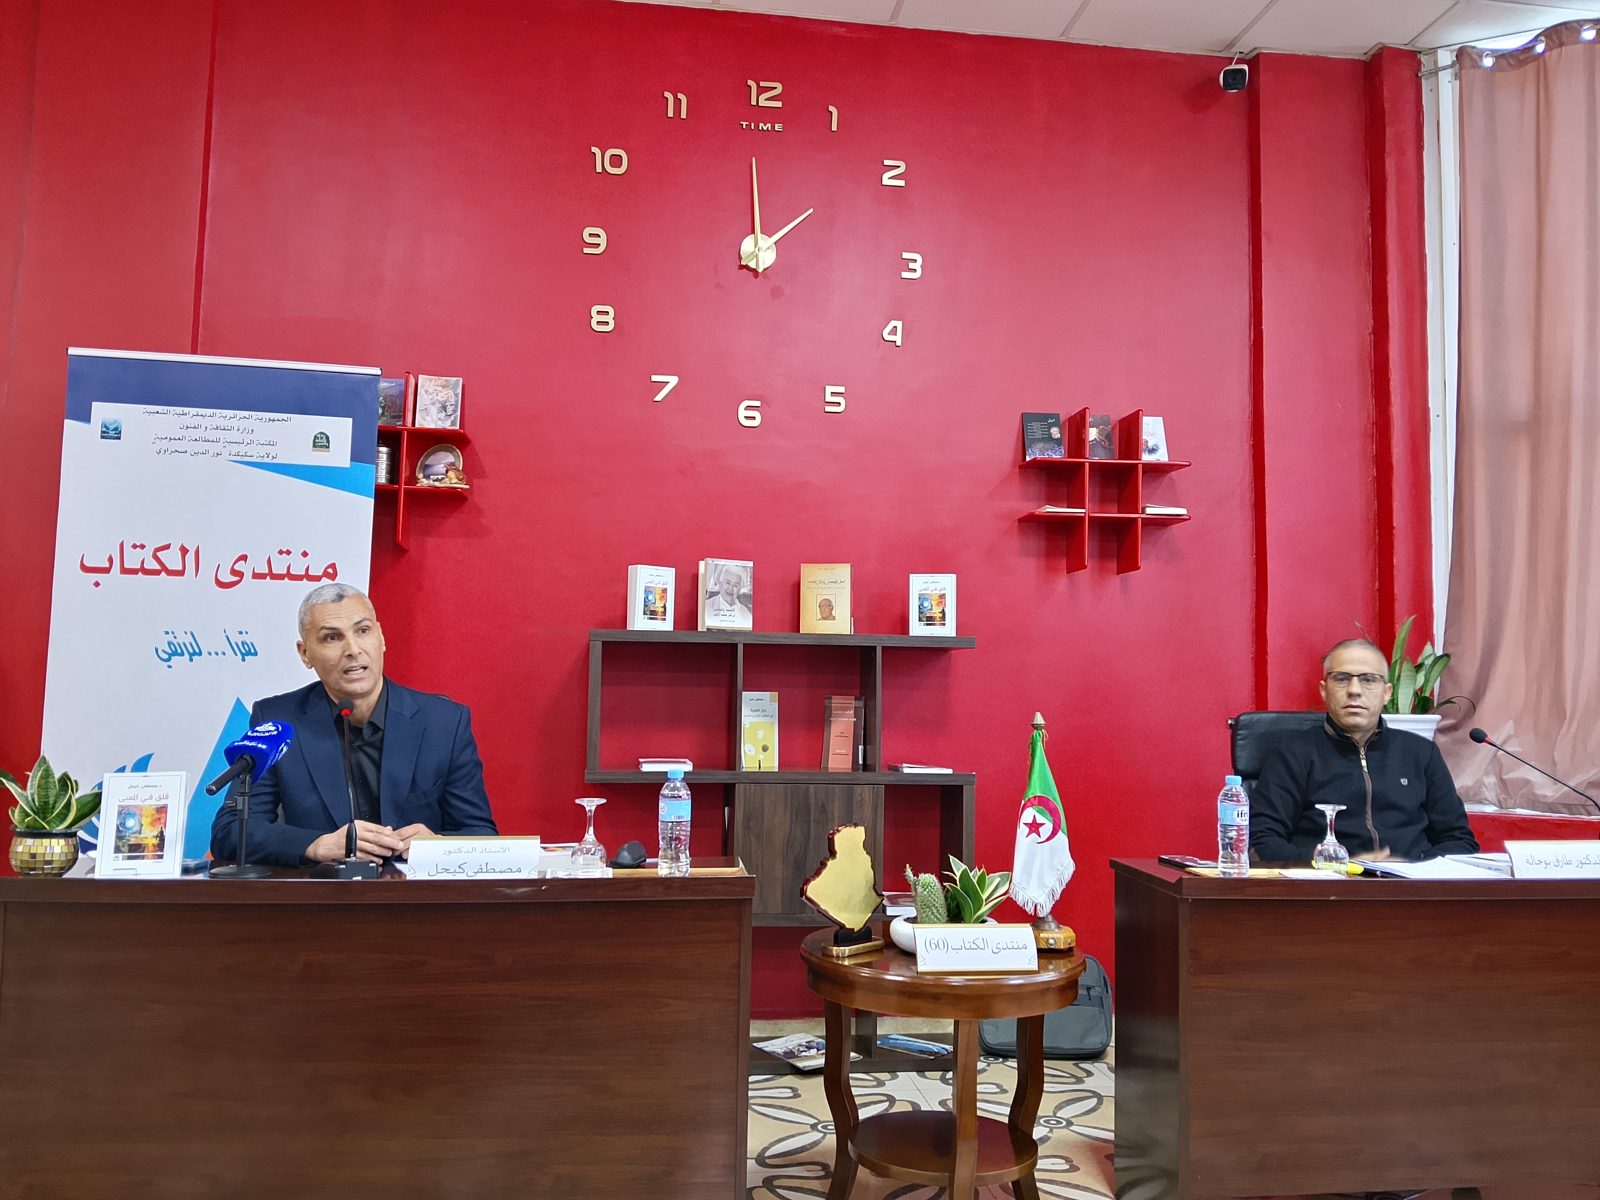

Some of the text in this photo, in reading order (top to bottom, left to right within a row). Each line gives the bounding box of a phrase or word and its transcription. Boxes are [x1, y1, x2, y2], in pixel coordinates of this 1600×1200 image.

[747, 79, 783, 108] 12
[663, 91, 688, 119] 11
[740, 121, 784, 132] TIME
[828, 105, 838, 132] 1
[590, 146, 628, 175] 10
[881, 159, 906, 187] 2
[582, 226, 607, 255] 9
[901, 252, 923, 280] 3
[590, 305, 615, 332] 8
[882, 320, 903, 346] 4
[650, 374, 679, 402] 7
[824, 385, 846, 413] 5
[142, 407, 292, 423] الجمهورية الجزائرية الديمقراطية الشعبية
[737, 399, 762, 428] 6
[179, 422, 202, 431] الفنون
[209, 423, 235, 431] الثقافة
[236, 425, 254, 435] وزارة
[187, 435, 221, 444] للمطالعة
[222, 437, 255, 446] الرئيسية
[255, 439, 278, 447] المكتبة
[190, 448, 210, 456] الدين
[227, 449, 254, 459] سكيكدة
[79, 539, 339, 590] منتدى الكتاب
[427, 861, 522, 877] مصطفى كيحل
[1553, 853, 1572, 869] طارق
[1575, 852, 1600, 869] لدكتور
[924, 936, 1028, 954] منتدى الكتاب (60)
